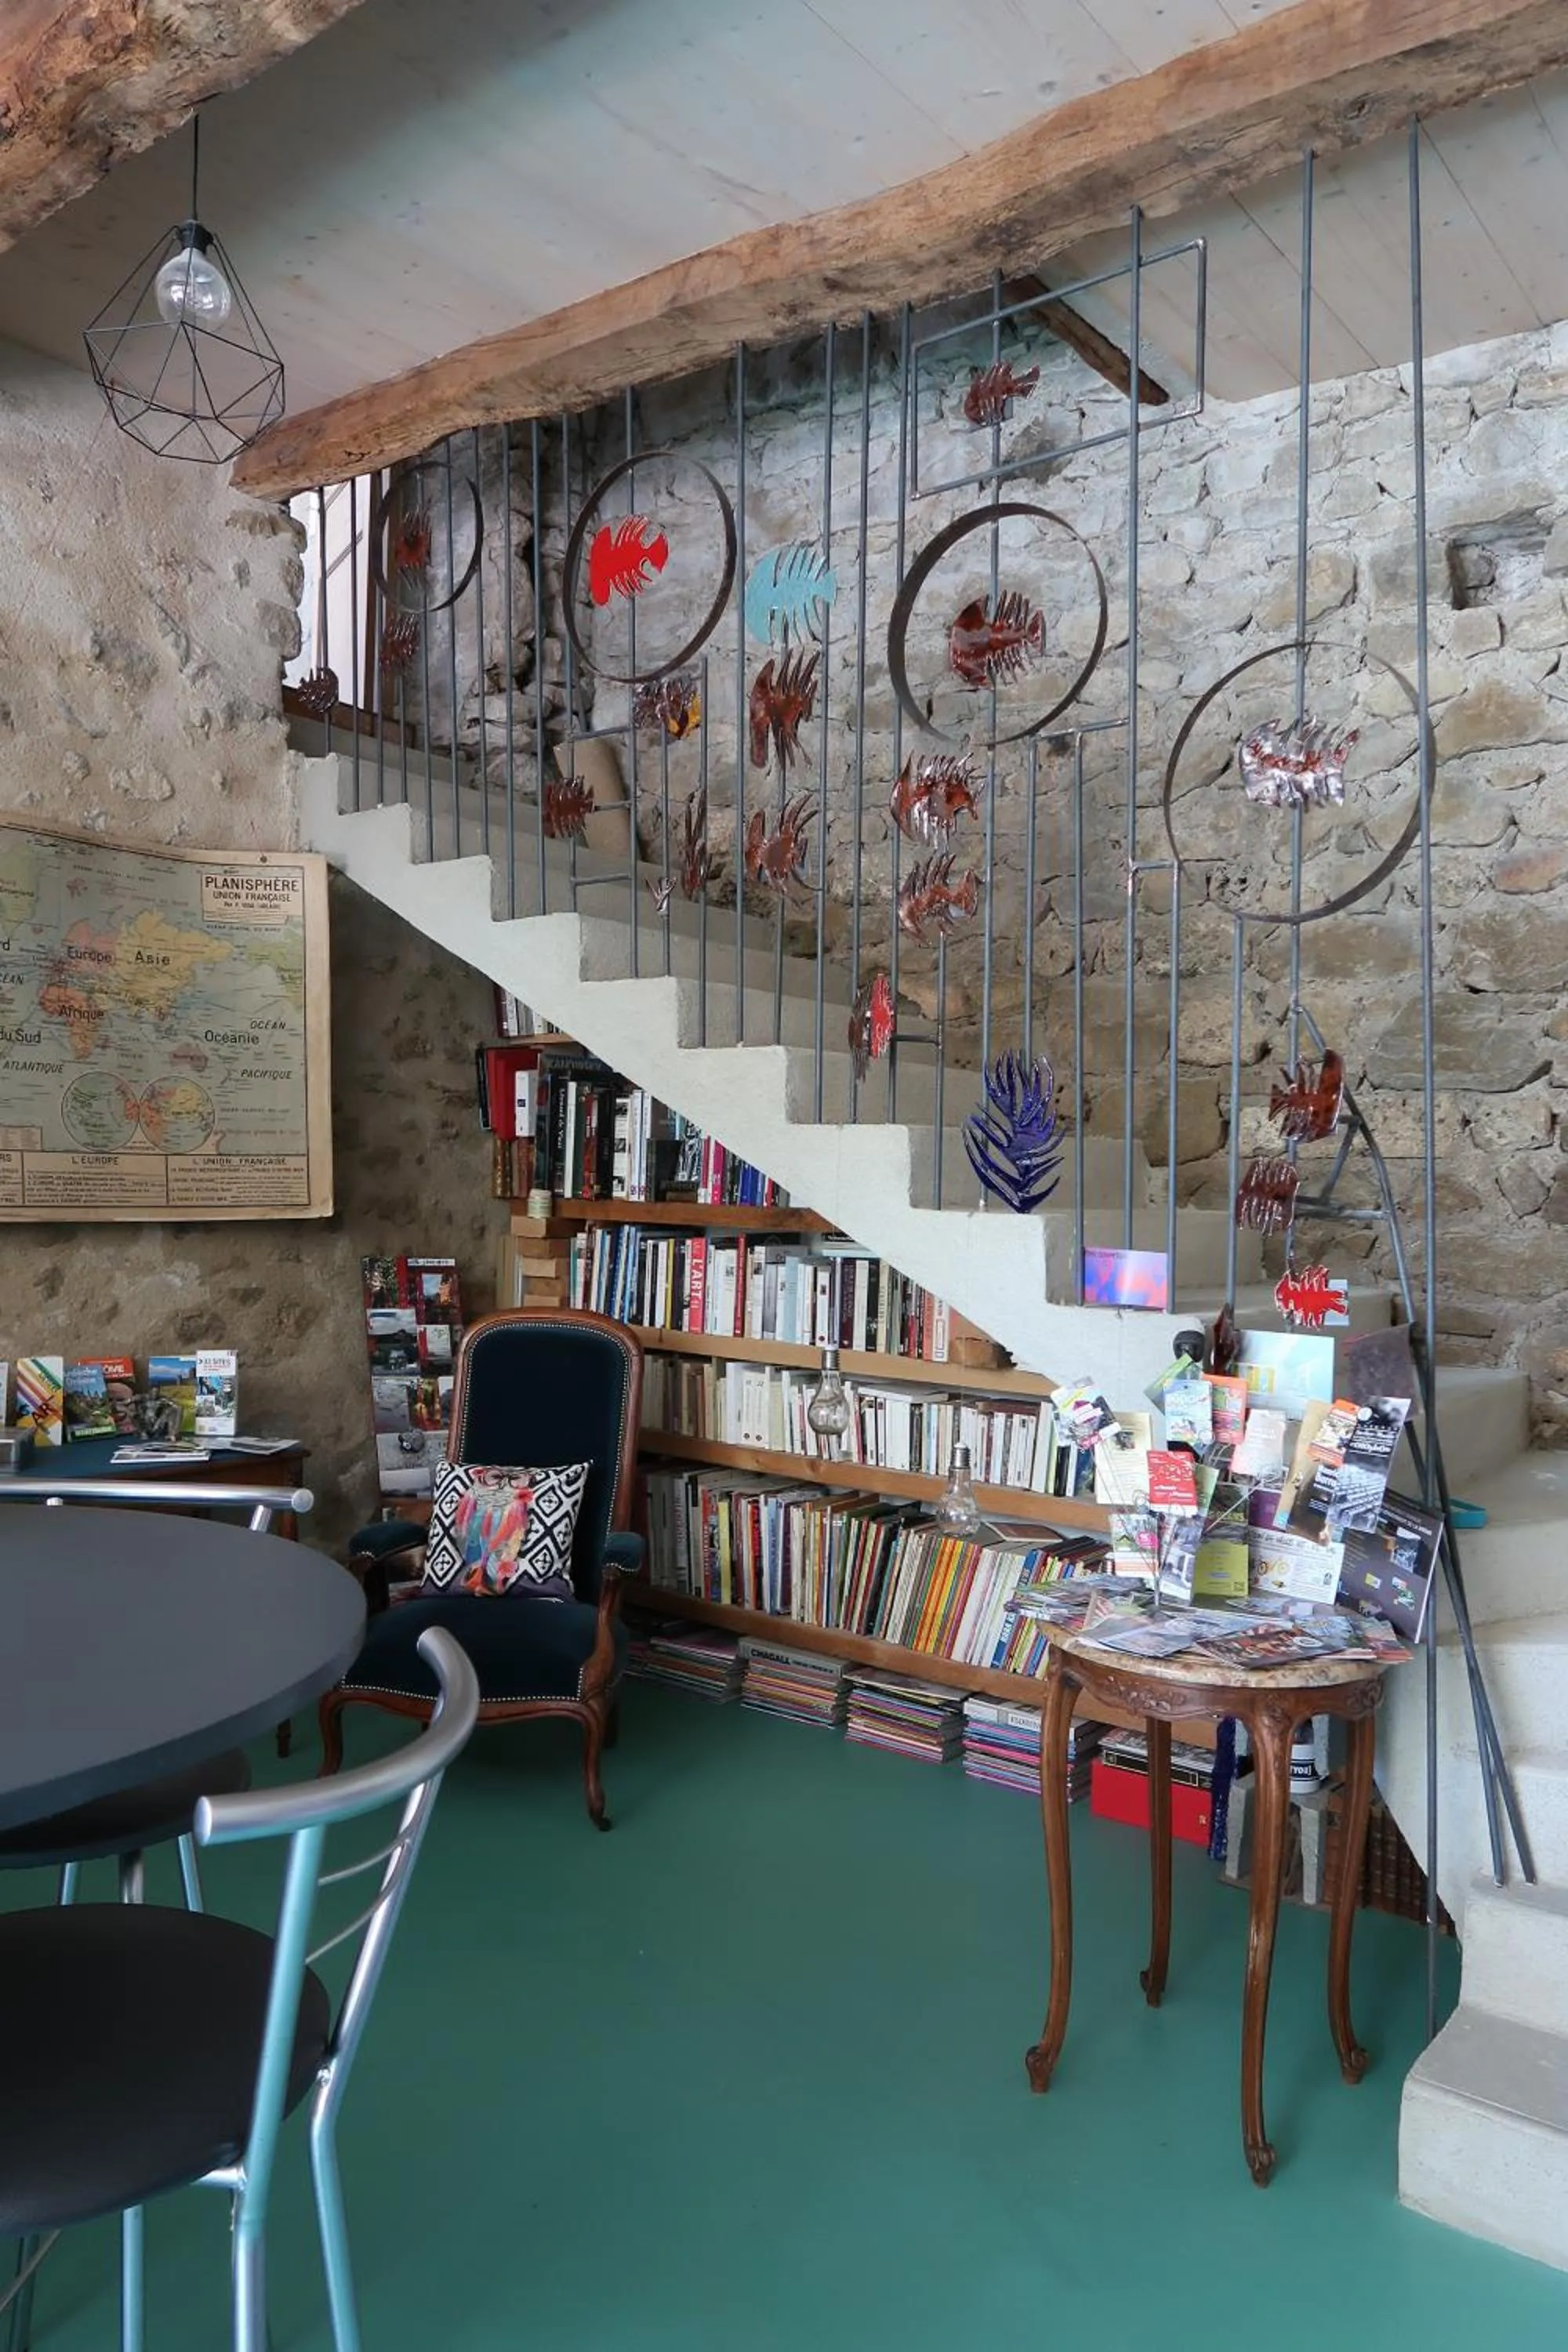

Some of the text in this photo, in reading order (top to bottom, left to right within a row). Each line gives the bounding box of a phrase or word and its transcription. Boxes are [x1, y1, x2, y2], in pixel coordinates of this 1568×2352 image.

[205, 876, 299, 892] PLANISPHÈRE
[212, 891, 292, 903] UNION FRANÇAISE
[67, 946, 112, 964] Europe
[135, 949, 170, 966] Asie
[59, 1005, 105, 1022] Afrique
[16, 1028, 42, 1044] Sud
[205, 1029, 260, 1045] Océanie
[2, 1060, 64, 1074] ATLANTIQUE
[240, 1069, 292, 1080] PACIFIQUE
[691, 1258, 703, 1299] L'ART
